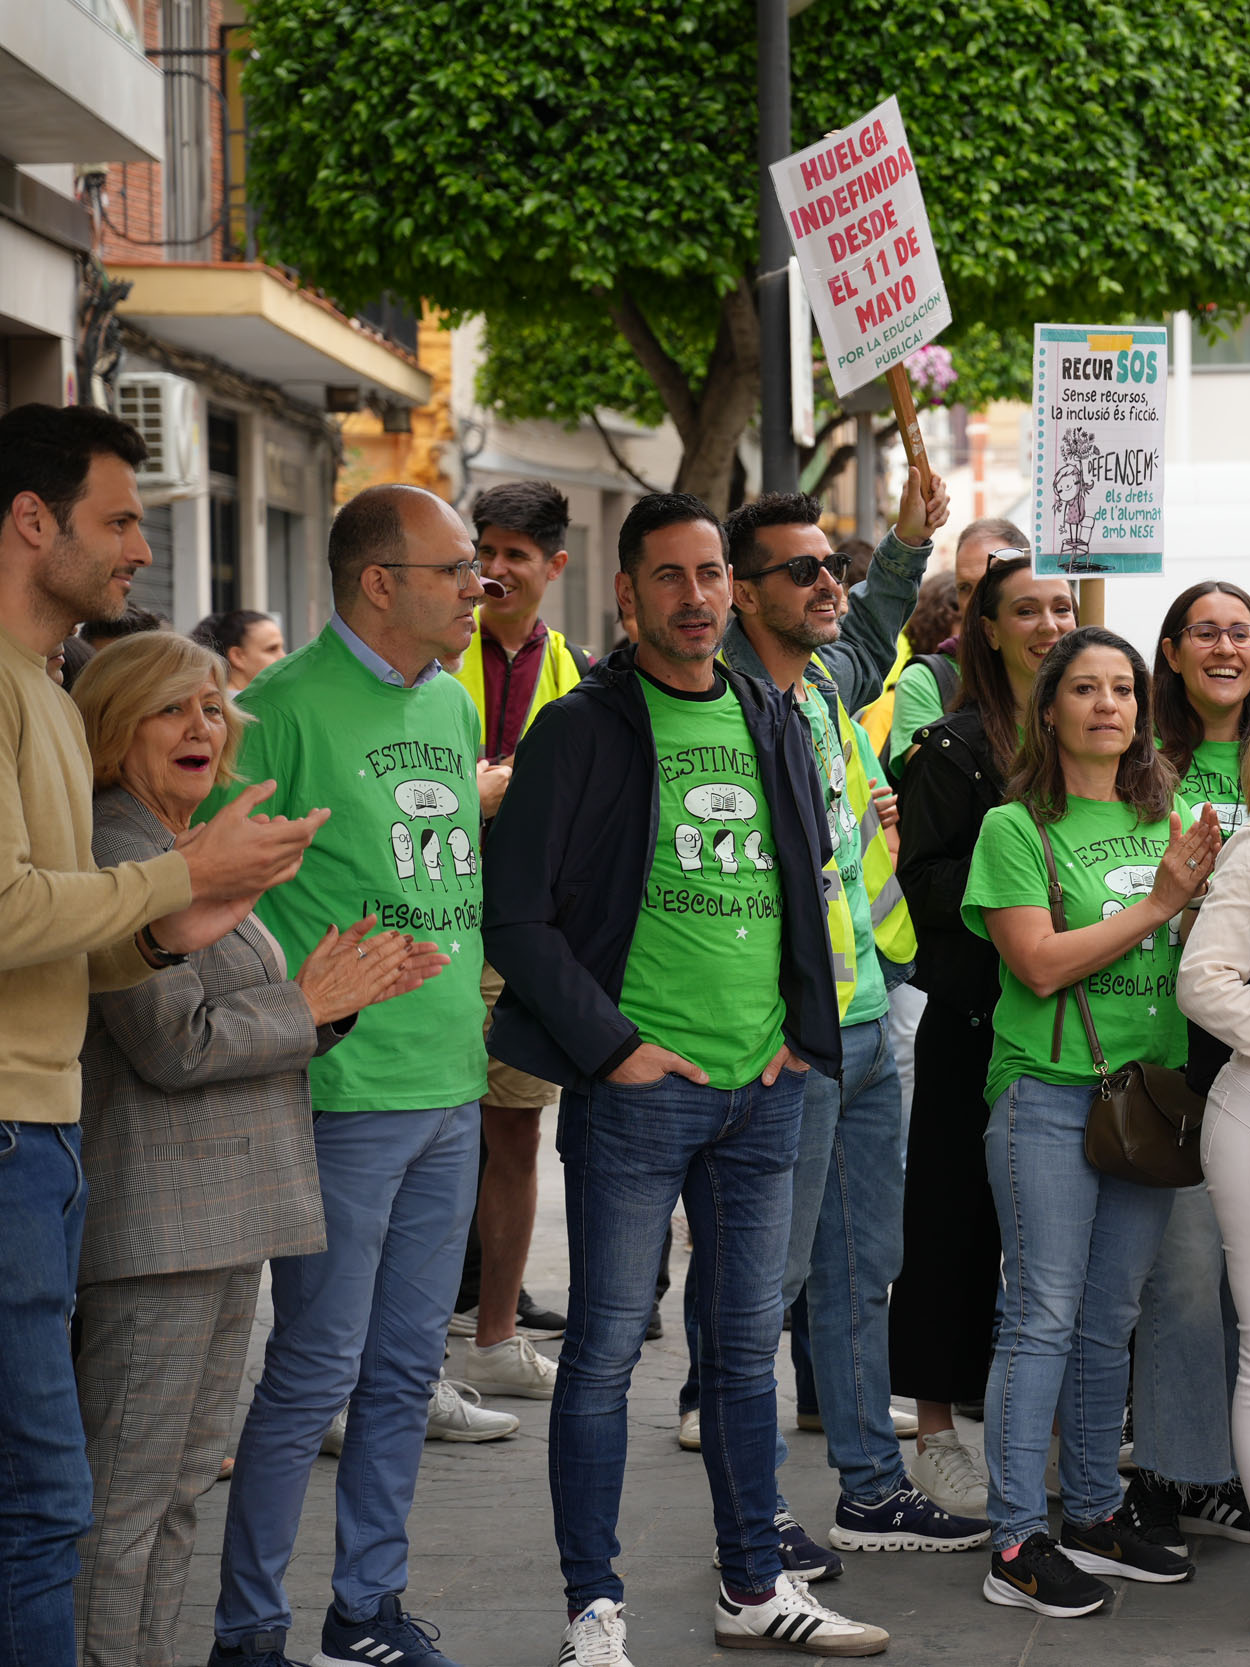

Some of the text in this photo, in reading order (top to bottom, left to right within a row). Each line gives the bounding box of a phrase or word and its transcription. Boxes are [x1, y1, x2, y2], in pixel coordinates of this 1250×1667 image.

[800, 119, 888, 192] HUELGA
[790, 146, 914, 240] INDEFINIDA
[828, 200, 899, 264] DESDE
[827, 226, 921, 306] EL 11 DE
[855, 274, 916, 334] MAYO
[838, 293, 941, 369] POR LA EDUCACIÓN
[875, 330, 923, 369] PÚBLICA!
[1052, 406, 1159, 422] la inclusió és ficció.
[1062, 388, 1149, 406] Sense recursos,
[1088, 450, 1152, 486] DEFENSEM
[1094, 505, 1161, 521] de l'alumnat
[1106, 488, 1153, 503] els drets
[1102, 524, 1154, 539] amb NESE
[366, 740, 465, 780] ESTIMEM
[1073, 835, 1171, 868] ESTIME
[454, 898, 483, 931] PÚBLI
[645, 885, 782, 919] L'ESCOLA PÚBLI
[1088, 970, 1153, 996] ESCOLA
